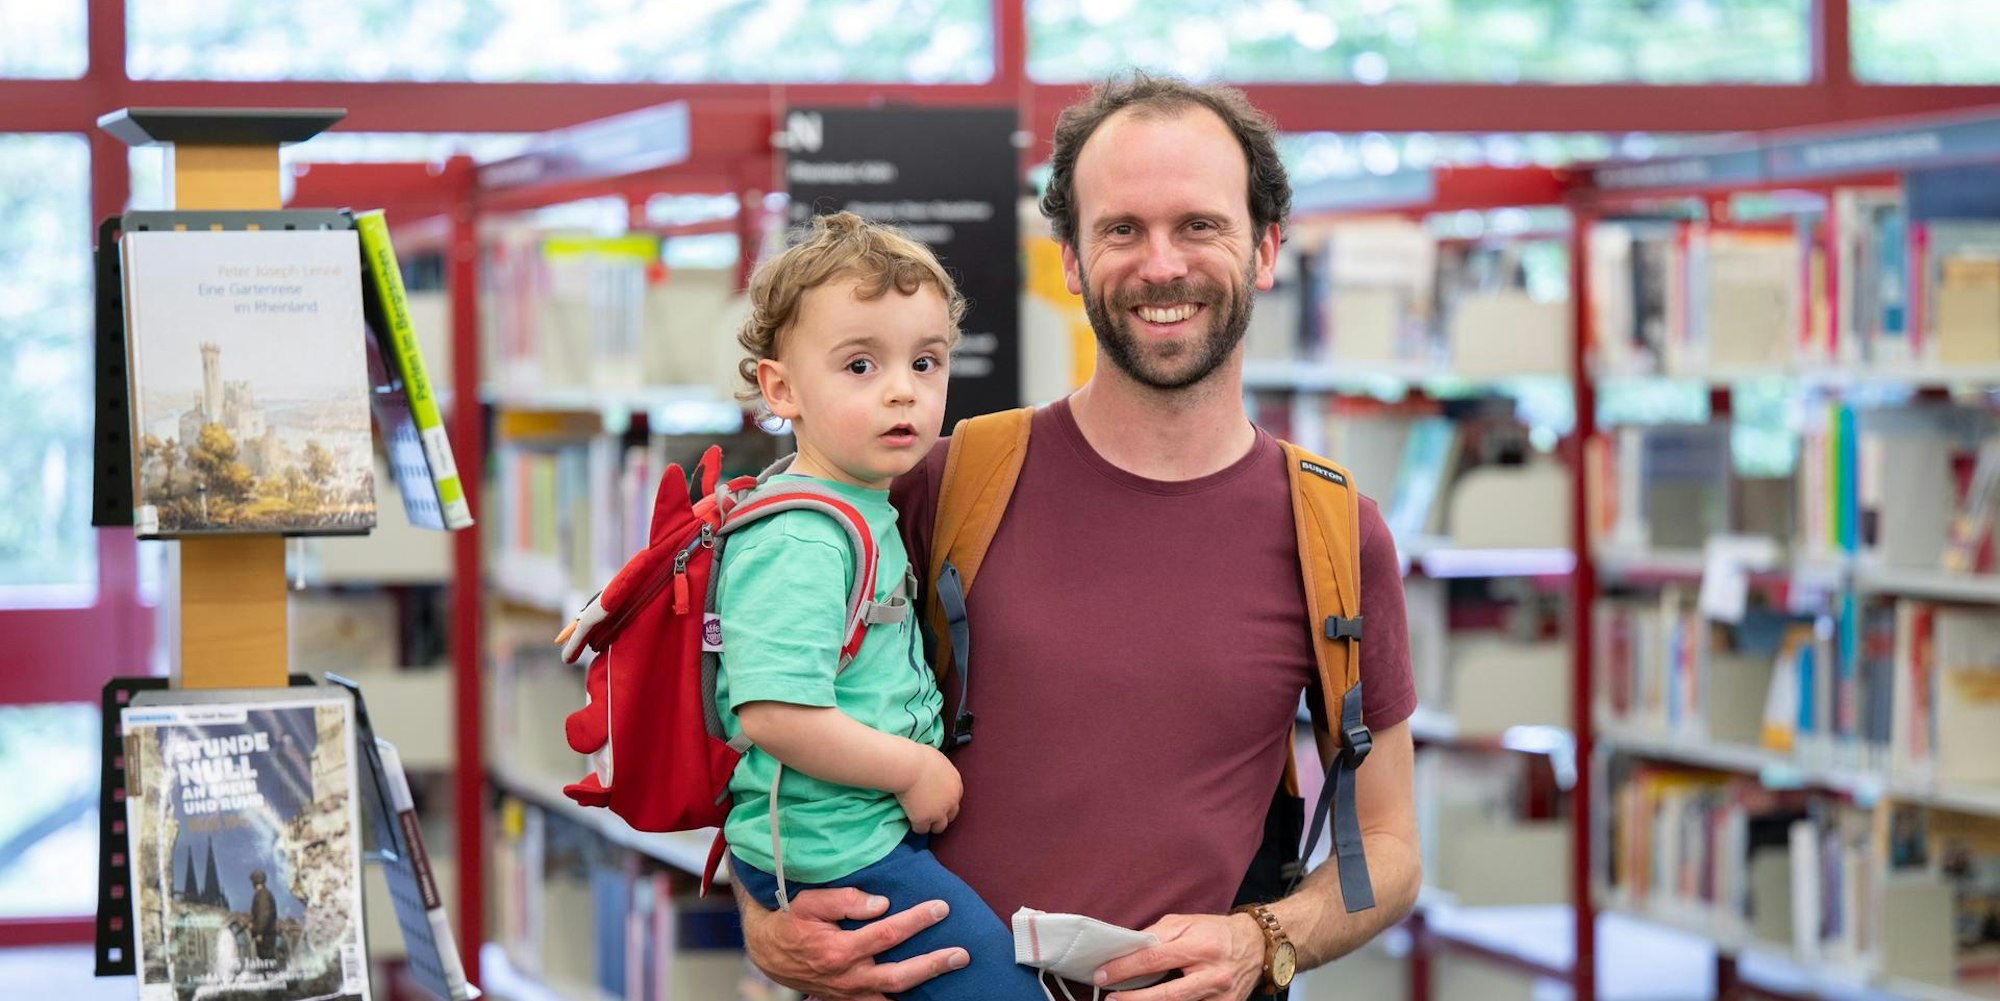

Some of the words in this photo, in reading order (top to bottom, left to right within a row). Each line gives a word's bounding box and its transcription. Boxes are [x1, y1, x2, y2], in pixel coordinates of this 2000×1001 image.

[217, 264, 250, 277] Peter
[255, 264, 298, 279] Joseph
[198, 283, 224, 296] Eine
[229, 283, 302, 296] Gartenreise
[234, 302, 250, 313] im
[254, 300, 319, 314] Rheinland
[1301, 461, 1343, 482] BURTON
[175, 732, 270, 760] STUNDE
[178, 755, 258, 786] NULL
[182, 785, 206, 800] AN
[183, 798, 218, 815] UND
